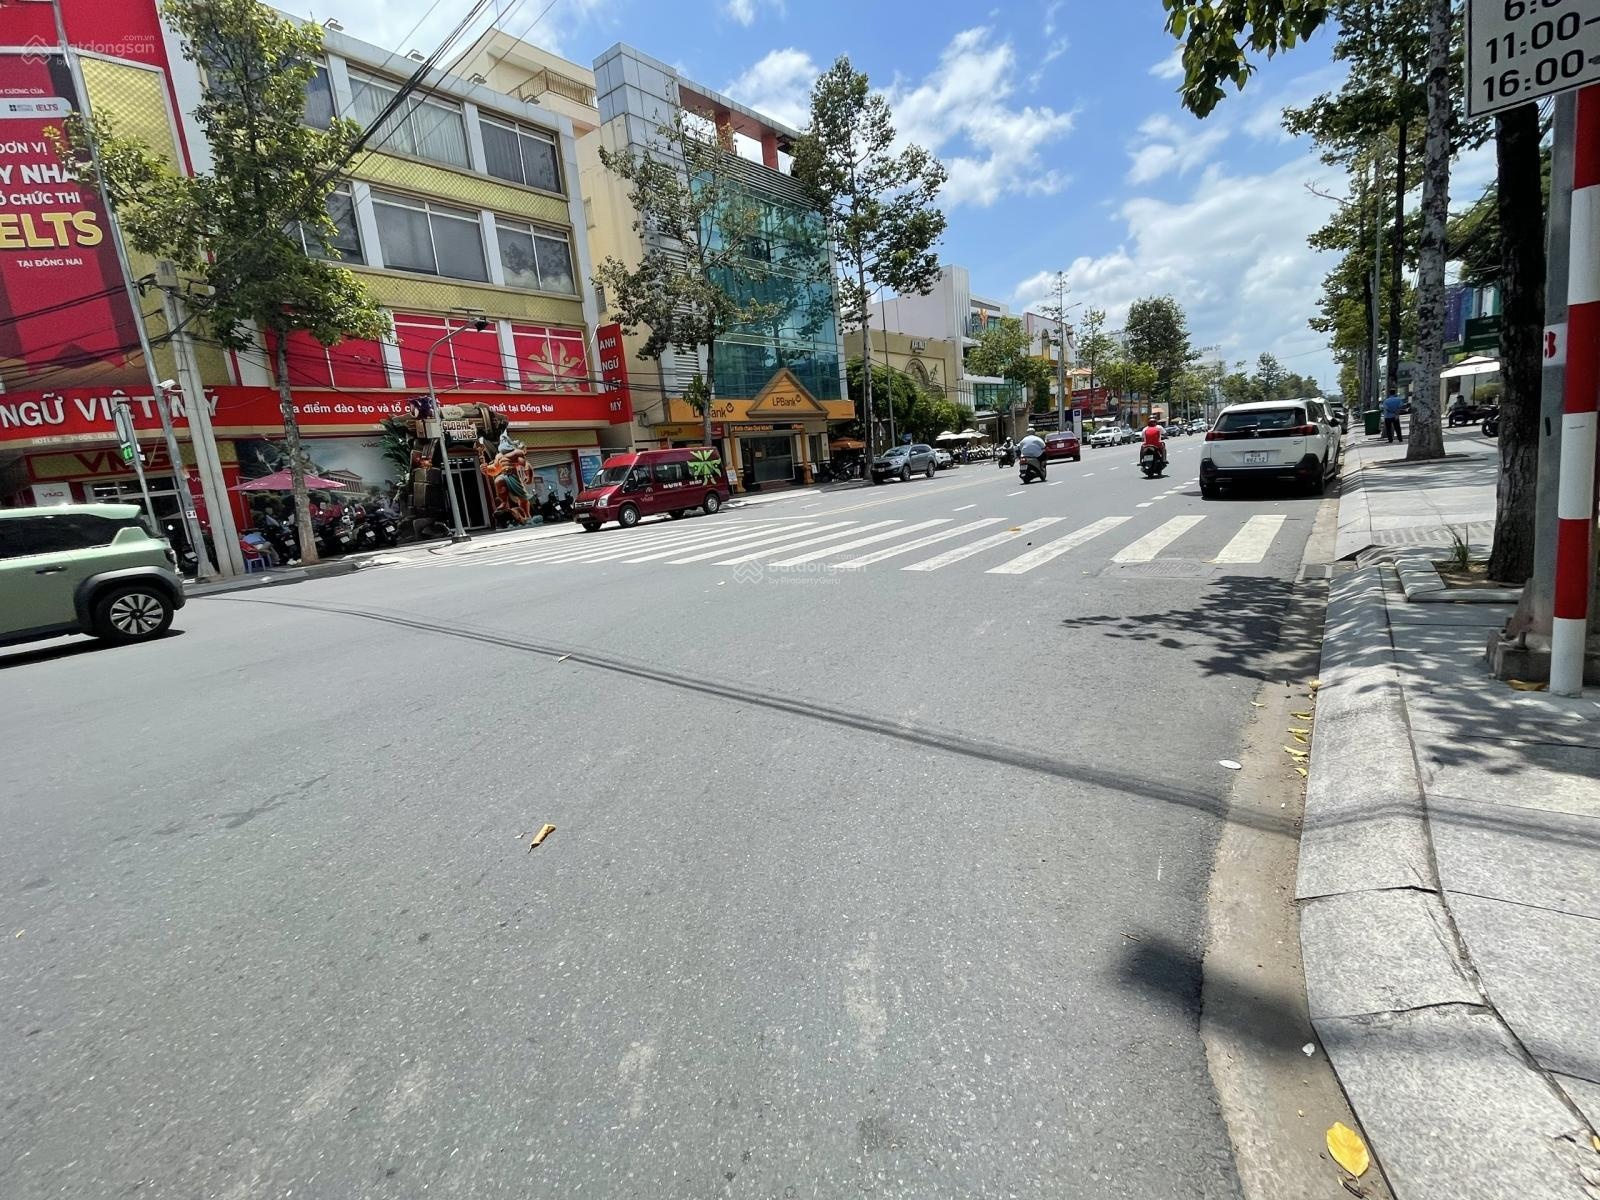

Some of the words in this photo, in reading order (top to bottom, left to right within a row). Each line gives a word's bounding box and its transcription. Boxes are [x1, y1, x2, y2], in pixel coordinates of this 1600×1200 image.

[31, 142, 48, 156] VỊ
[9, 191, 54, 205] CHỨC
[55, 192, 81, 204] THI
[17, 260, 34, 269] TẠI
[65, 258, 83, 266] NAI
[600, 337, 616, 351] ANH
[303, 402, 331, 413] điểm
[334, 403, 355, 413] đào
[358, 404, 375, 415] tạo
[377, 404, 389, 413] và
[391, 402, 402, 413] tổ
[509, 403, 519, 413] tại
[520, 402, 541, 414] Đồng
[542, 403, 554, 412] Nai
[772, 397, 797, 408] LPBank
[0, 392, 65, 428] NGỮ
[692, 406, 727, 418] Lank
